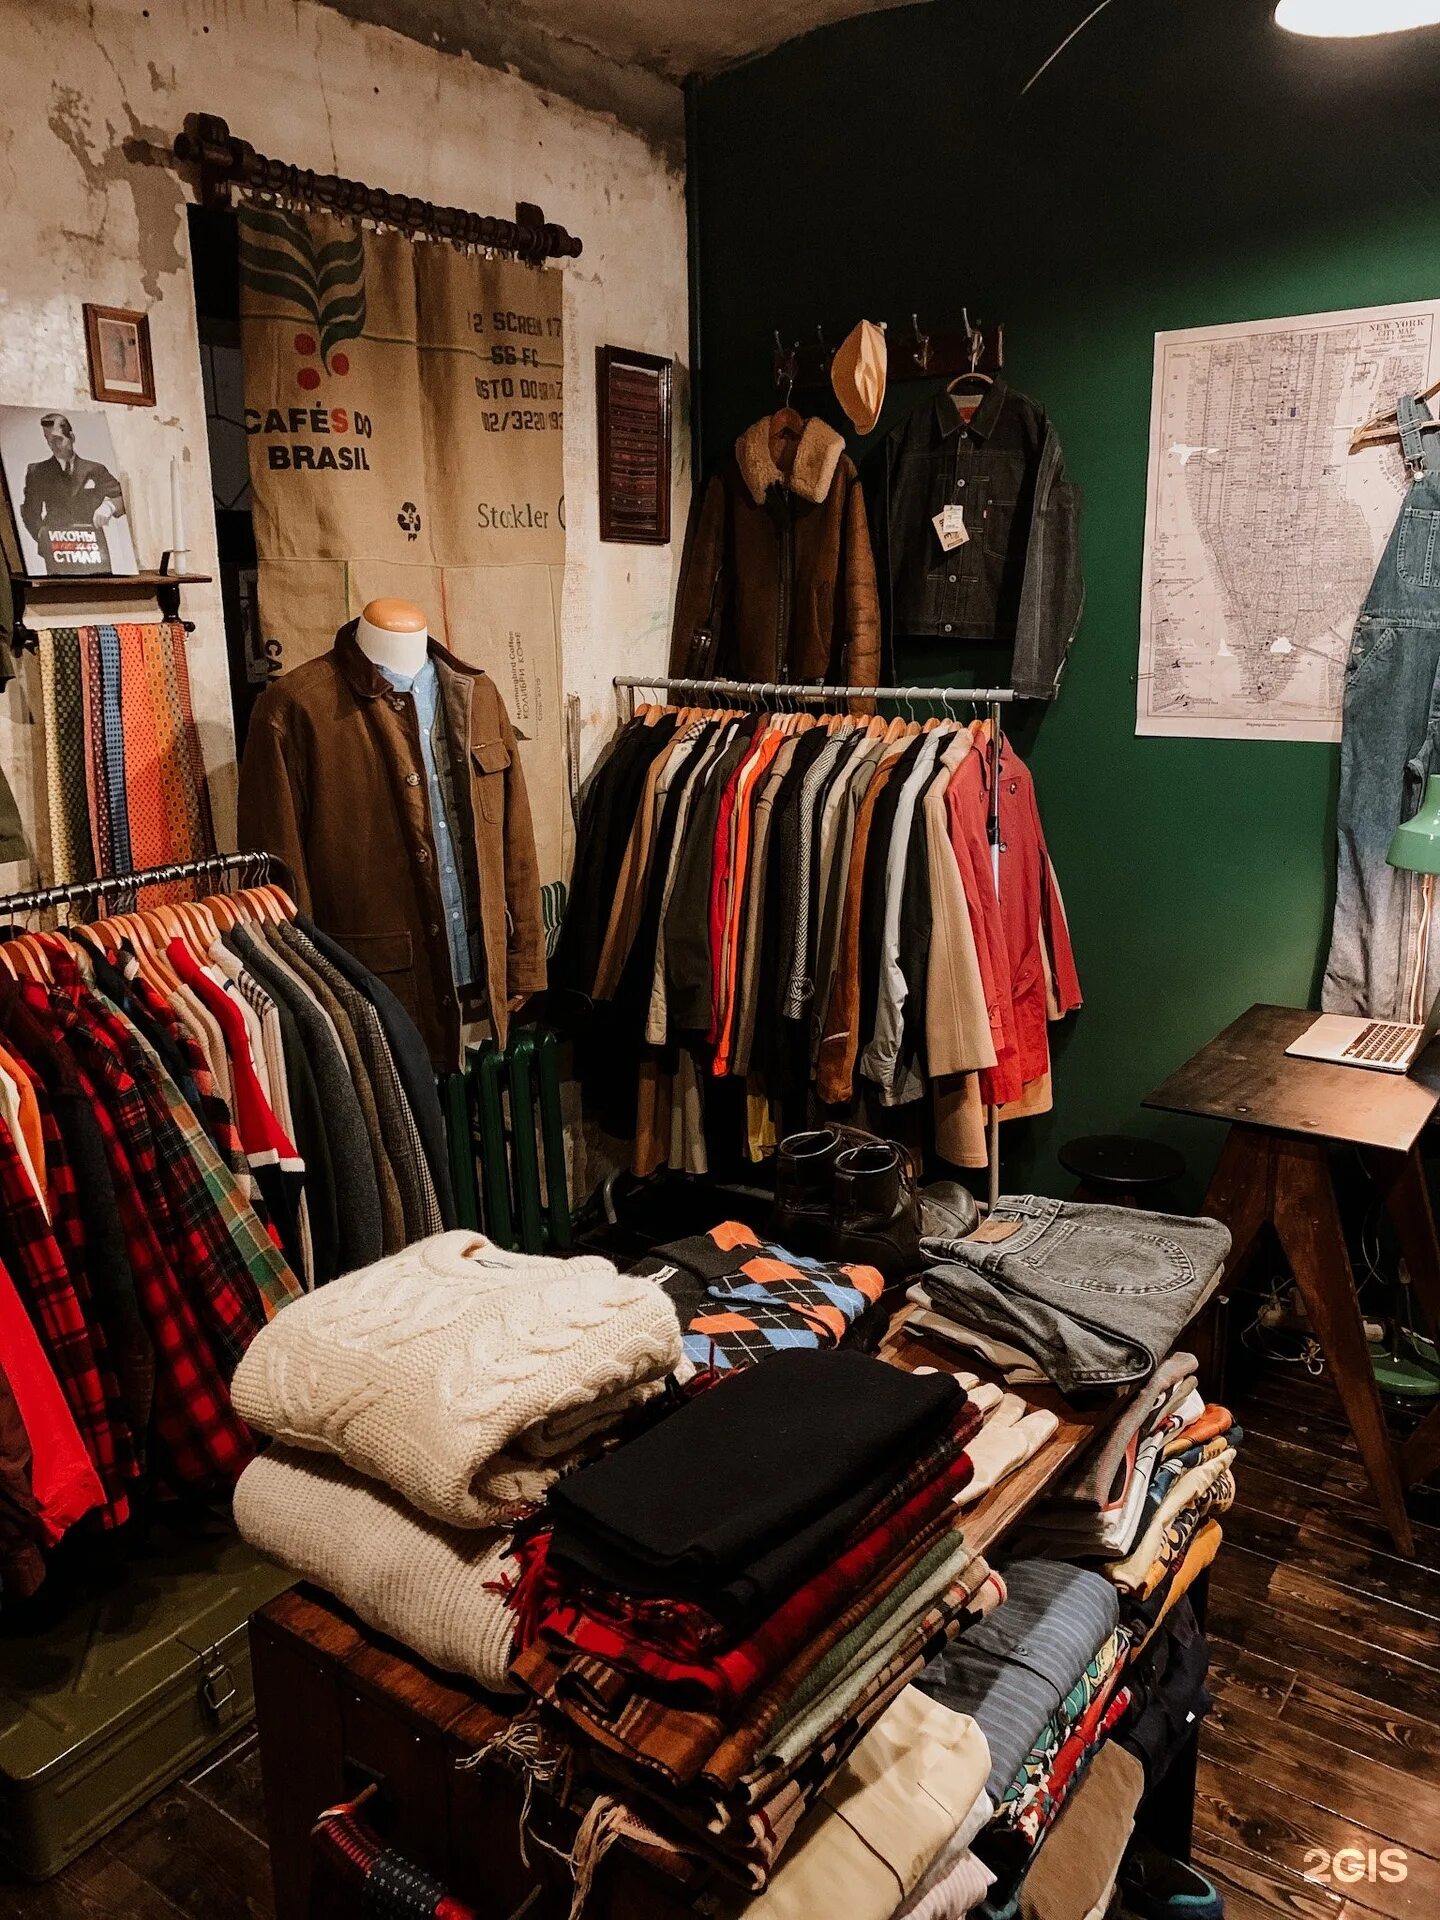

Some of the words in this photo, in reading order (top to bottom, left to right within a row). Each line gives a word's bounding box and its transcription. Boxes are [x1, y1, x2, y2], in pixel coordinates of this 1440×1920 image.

[1369, 323, 1391, 331] NEW
[1395, 319, 1424, 328] YORK
[244, 401, 348, 434] CAFÉS
[354, 411, 372, 438] DO
[268, 446, 370, 470] BRASIL
[48, 530, 97, 542] ИКОНЫ
[407, 533, 418, 541] PP
[53, 550, 102, 564] СТИЛЯ
[515, 632, 524, 663] КОФЕ
[511, 661, 522, 720] Hummingbird
[519, 668, 530, 719] КОЛИБРИ
